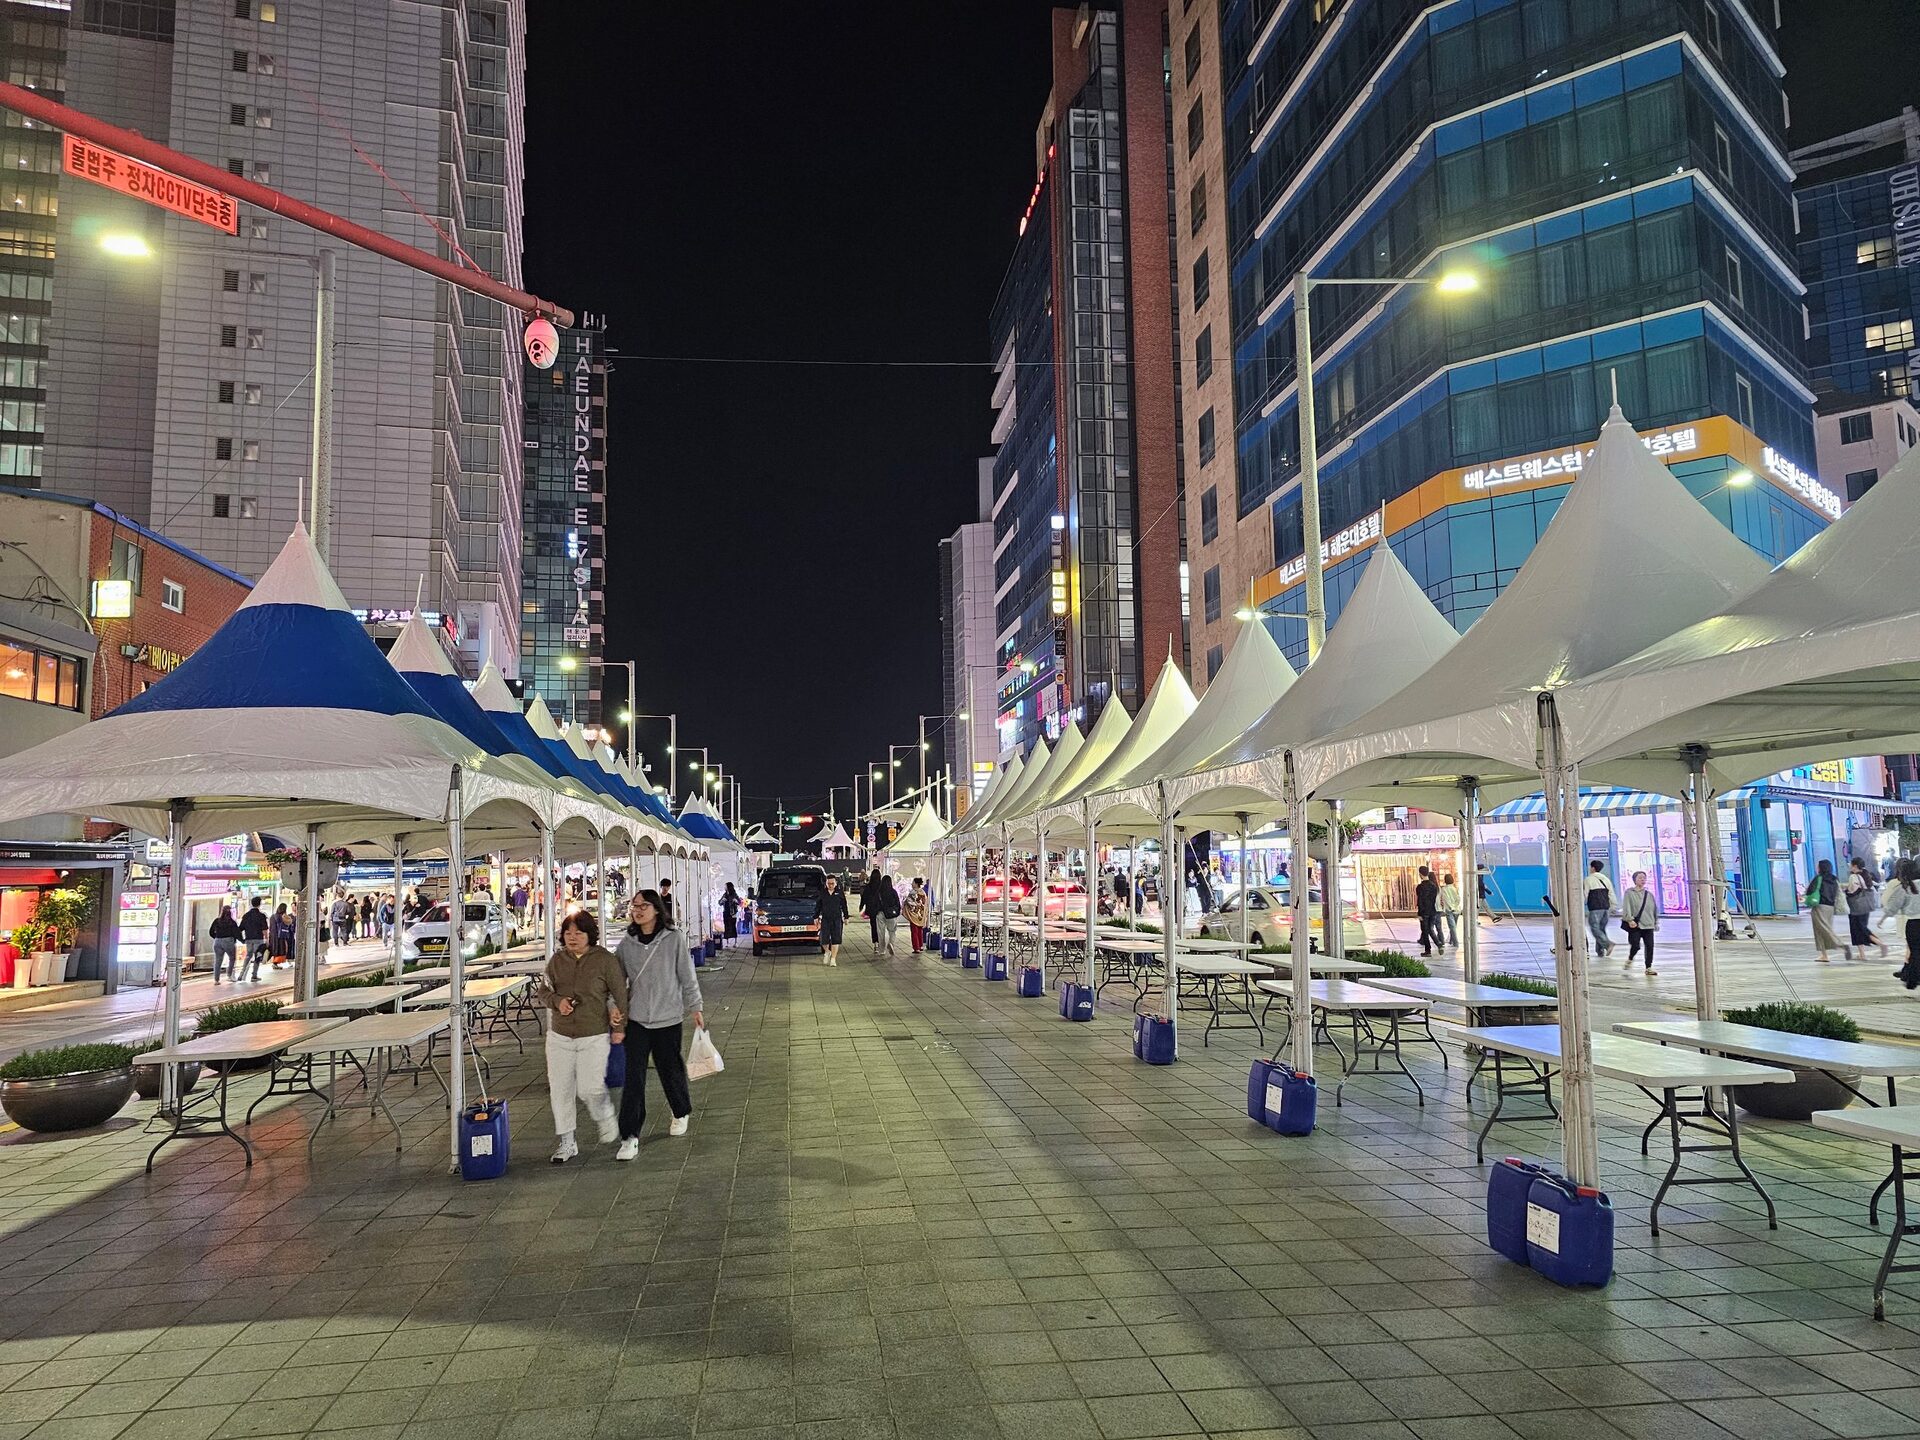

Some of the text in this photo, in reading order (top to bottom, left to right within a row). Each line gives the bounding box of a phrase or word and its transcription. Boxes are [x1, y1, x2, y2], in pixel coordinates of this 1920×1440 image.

[1889, 166, 1920, 205] UH
[573, 336, 591, 491] HAEUNDAE
[1464, 451, 1583, 489] 베스트웨스턴
[571, 508, 591, 625] ELYSIA
[1280, 512, 1380, 585] 베스트턴 해운대호텔
